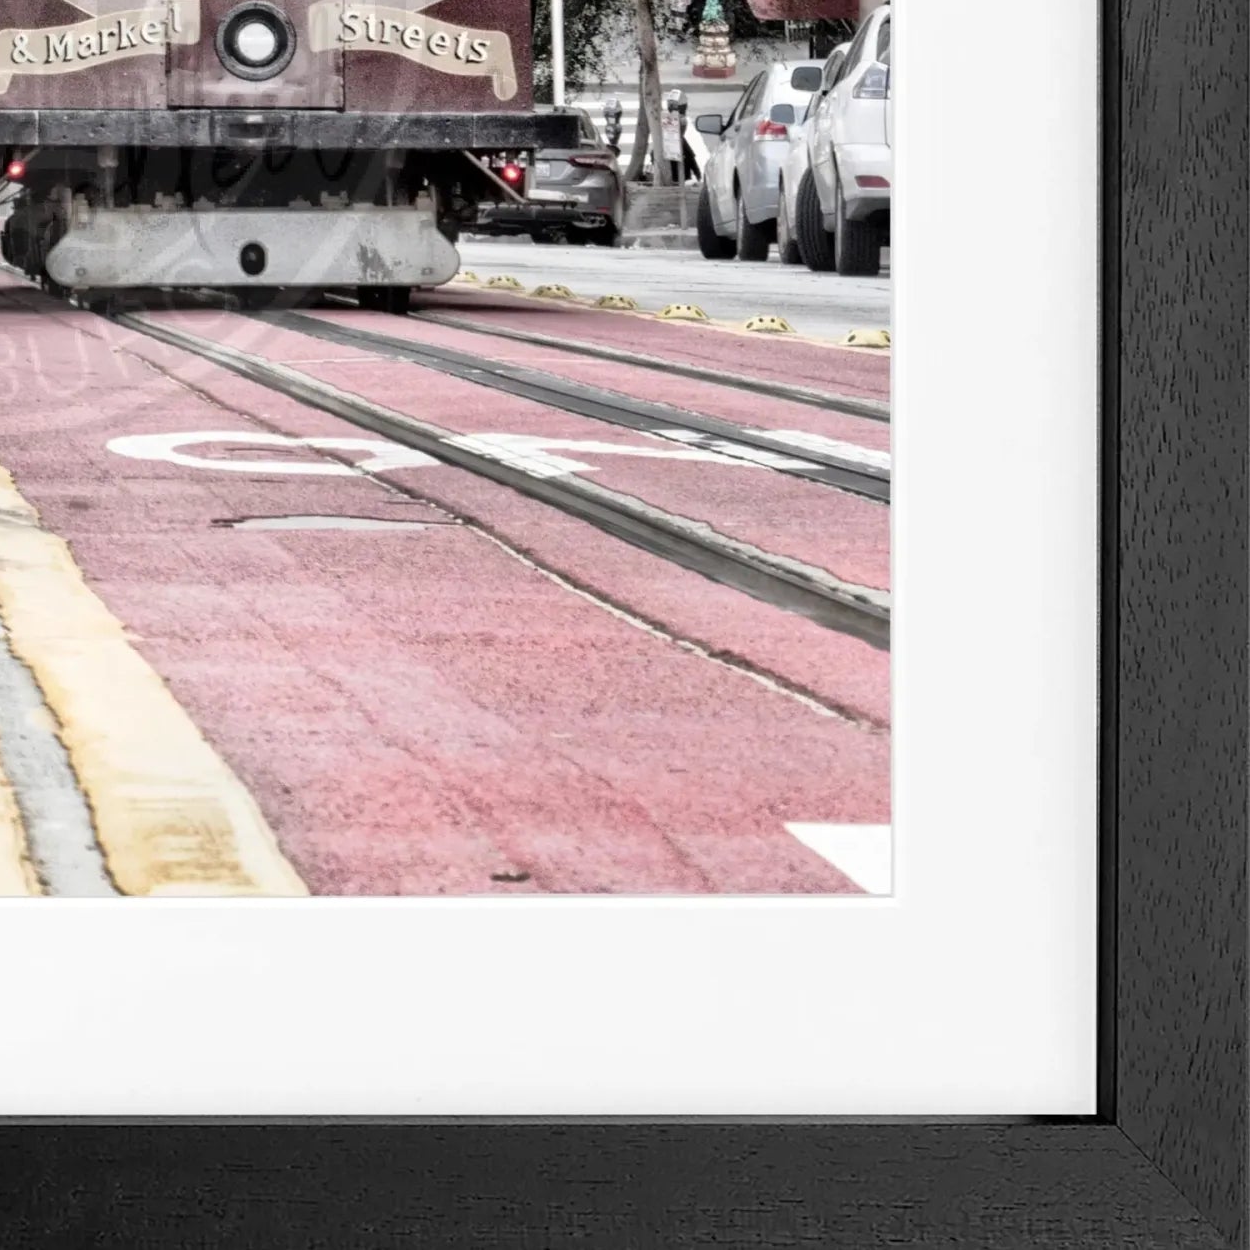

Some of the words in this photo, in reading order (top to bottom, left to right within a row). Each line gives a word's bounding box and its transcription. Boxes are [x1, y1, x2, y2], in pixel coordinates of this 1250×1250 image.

[11, 31, 38, 65] &
[43, 2, 183, 65] Market
[337, 10, 492, 64] Streets
